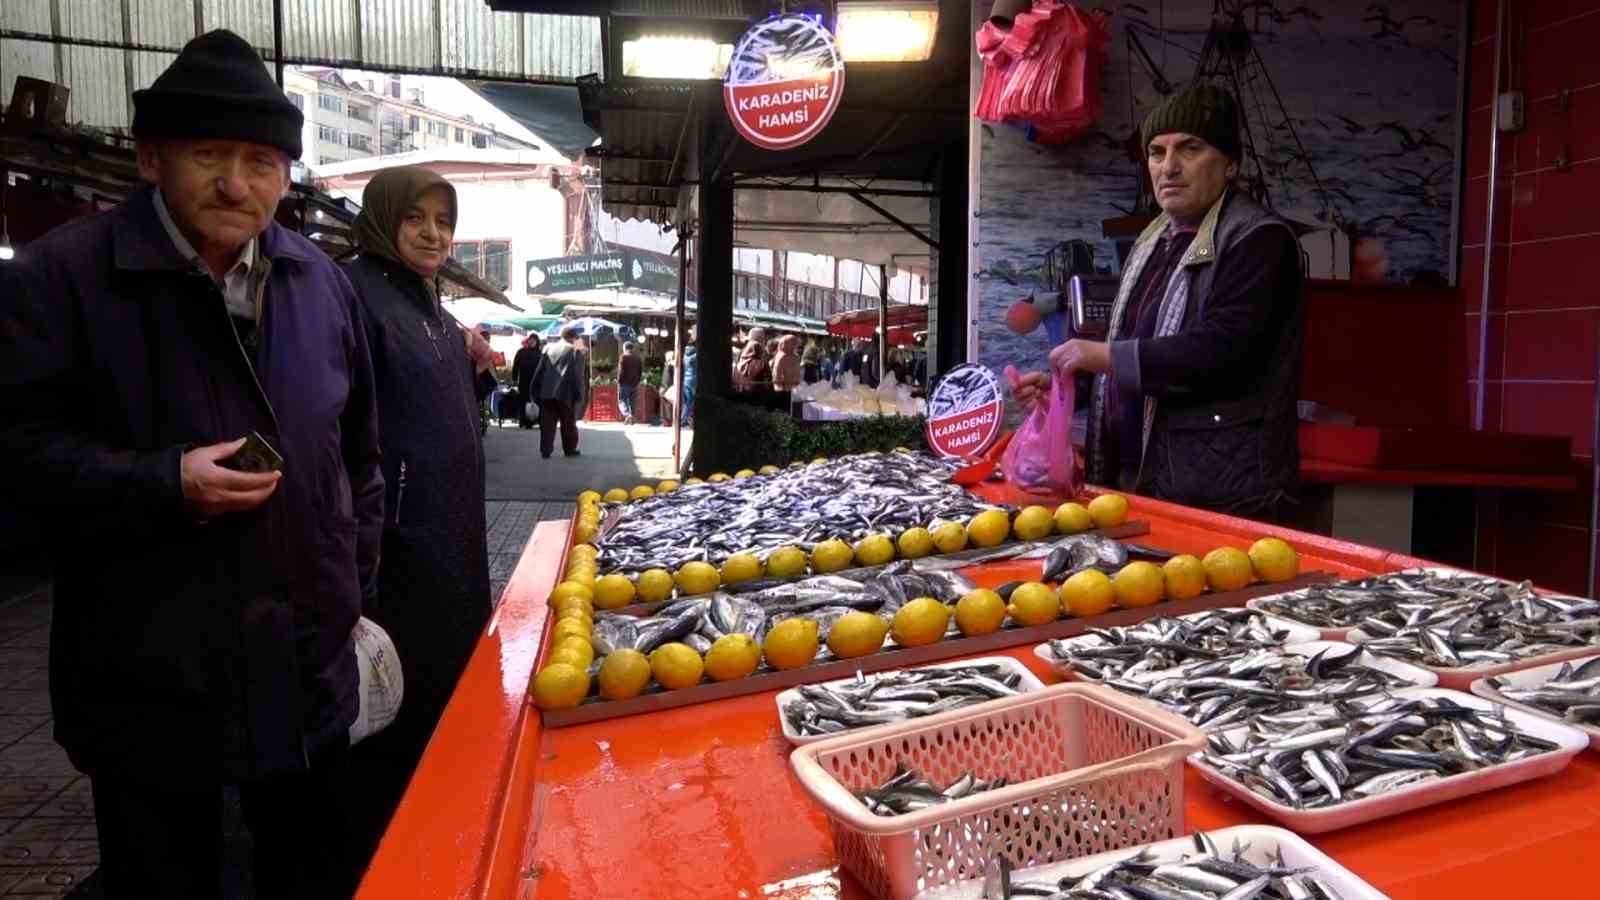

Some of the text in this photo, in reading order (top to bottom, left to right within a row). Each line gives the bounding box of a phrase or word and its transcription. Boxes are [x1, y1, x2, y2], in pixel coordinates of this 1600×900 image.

[739, 84, 829, 112] KARADENİZ
[758, 105, 809, 129] HAMSİ
[934, 411, 994, 438] KARADENİZ
[947, 429, 981, 449] HAMSİ
